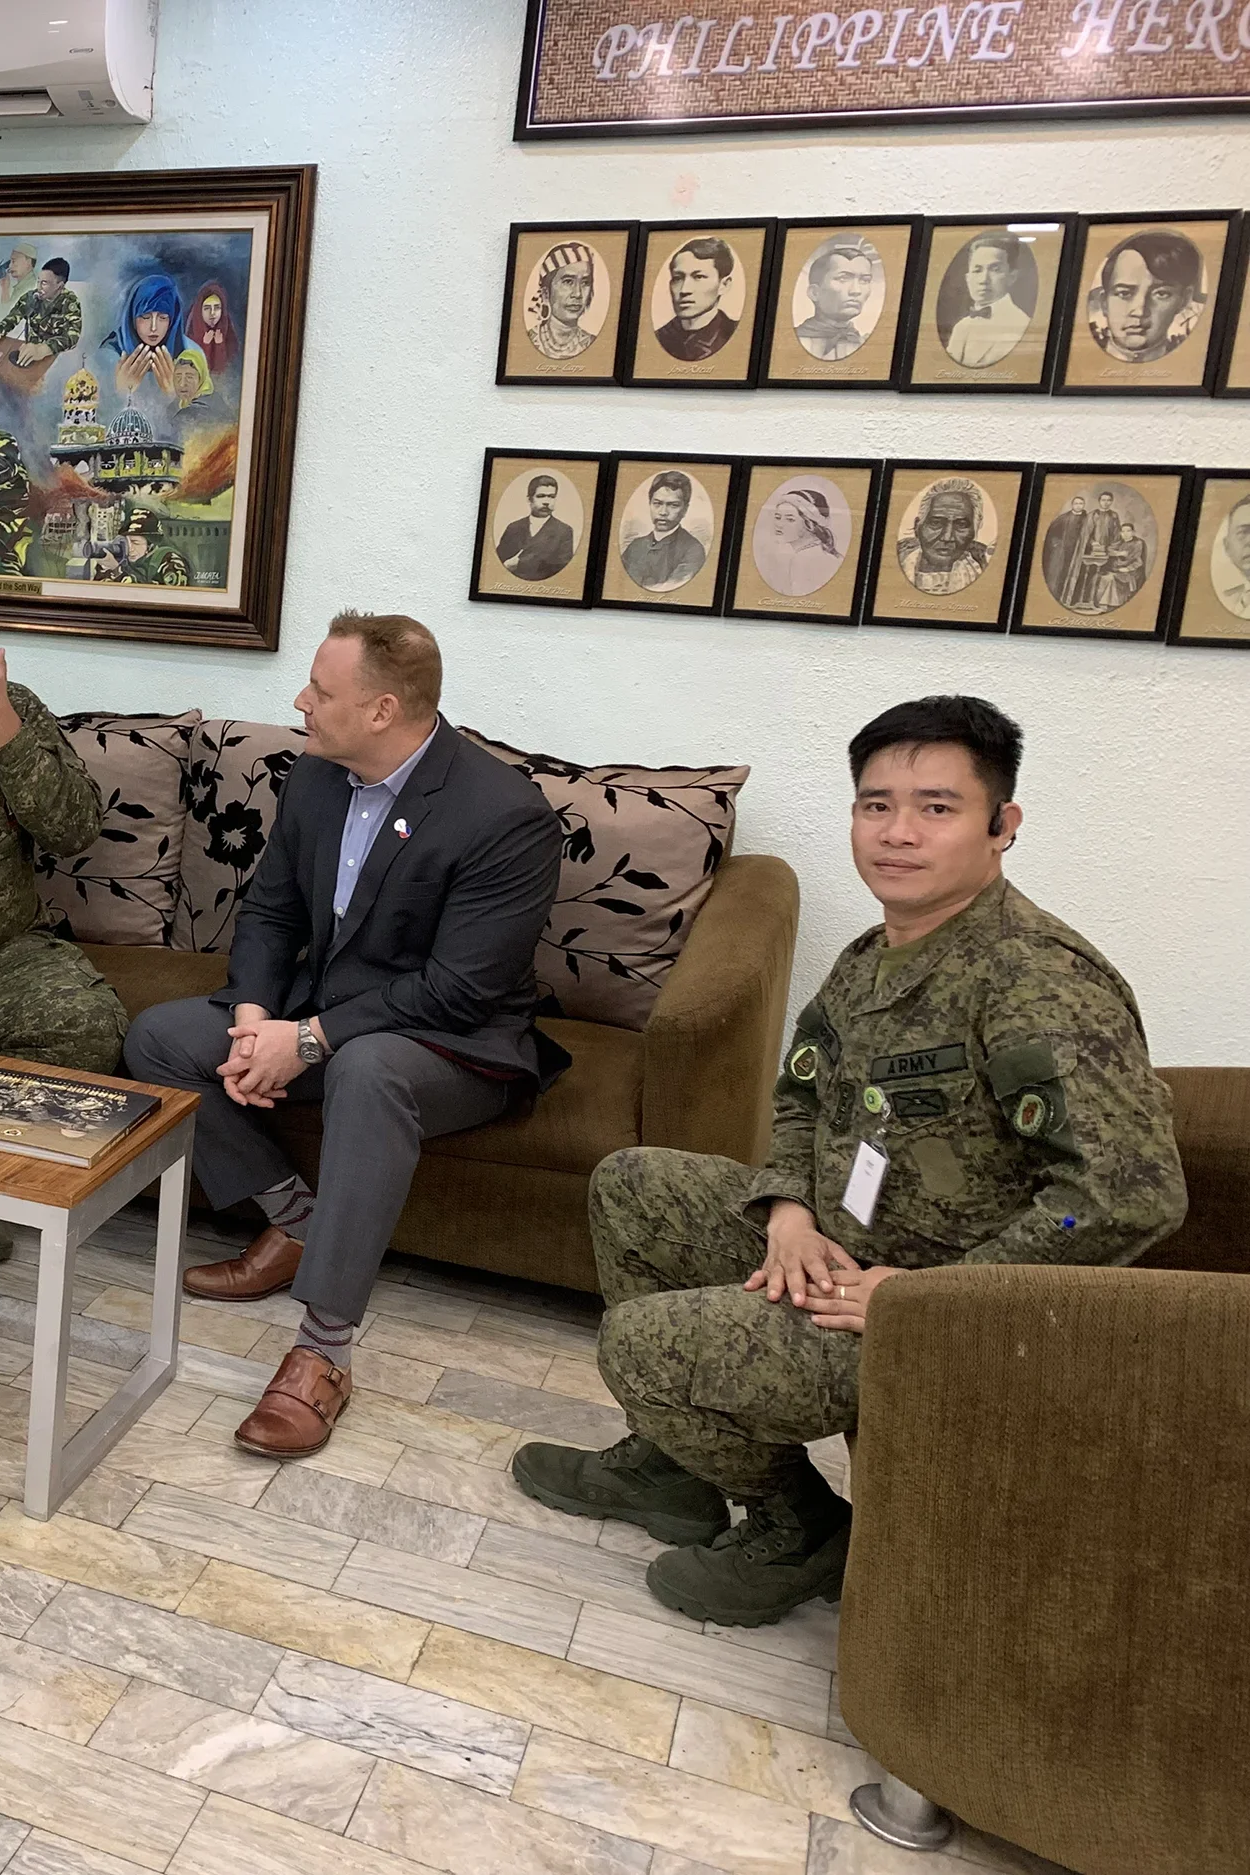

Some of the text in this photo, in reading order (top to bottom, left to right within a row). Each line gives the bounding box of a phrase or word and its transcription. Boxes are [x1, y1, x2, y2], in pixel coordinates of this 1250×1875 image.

[593, 0, 1023, 80] PHILIPPINE
[3, 582, 13, 590] the
[14, 583, 26, 591] Soft
[27, 584, 41, 593] Way
[888, 1053, 937, 1074] ARMY
